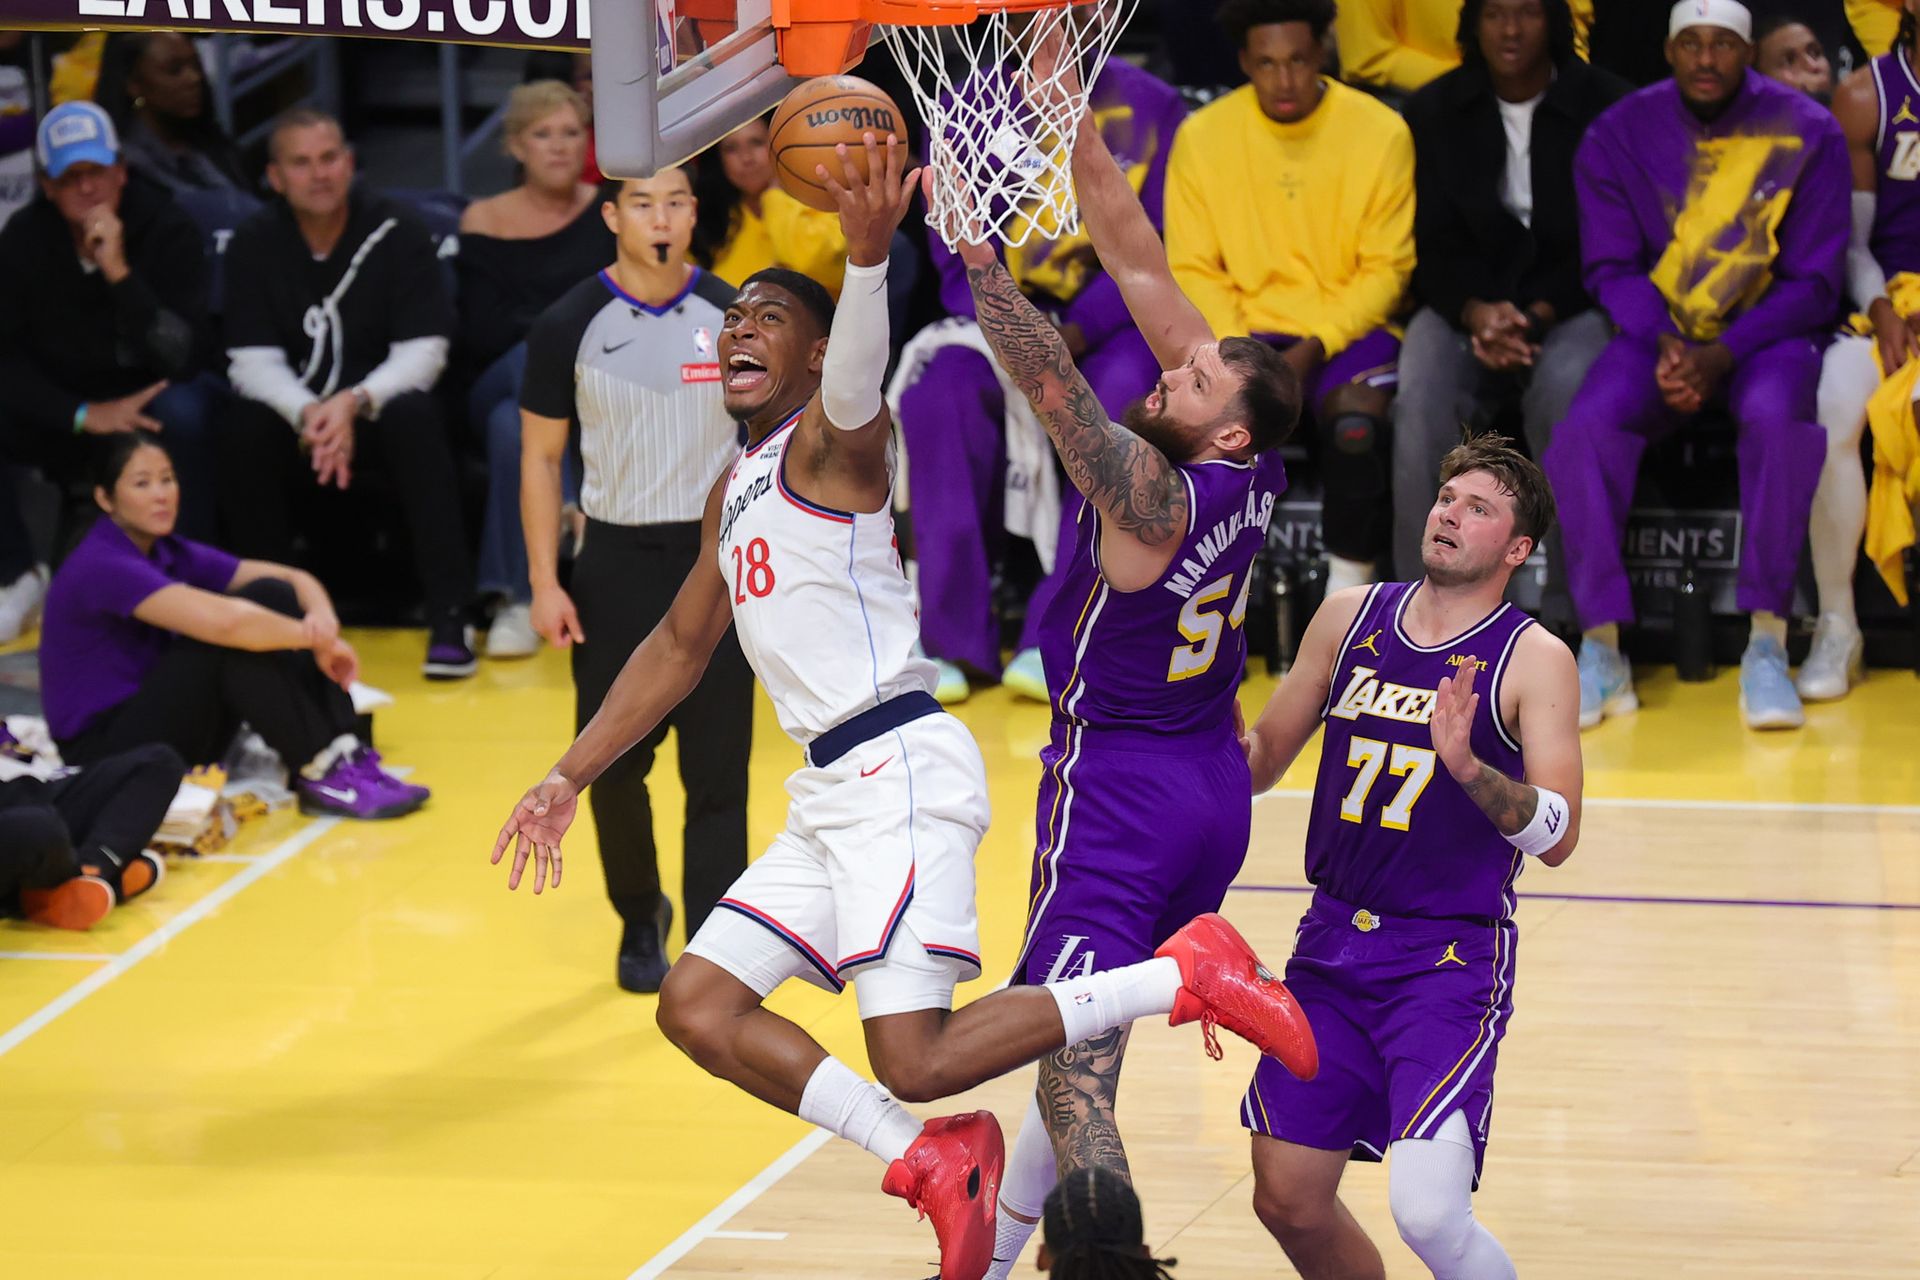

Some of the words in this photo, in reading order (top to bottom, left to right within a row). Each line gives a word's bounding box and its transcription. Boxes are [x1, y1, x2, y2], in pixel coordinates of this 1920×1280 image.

[806, 107, 895, 132] Wilson
[732, 537, 775, 606] 28
[1445, 654, 1488, 671] Alrt
[1340, 735, 1437, 832] 77
[1545, 802, 1561, 835] 77
